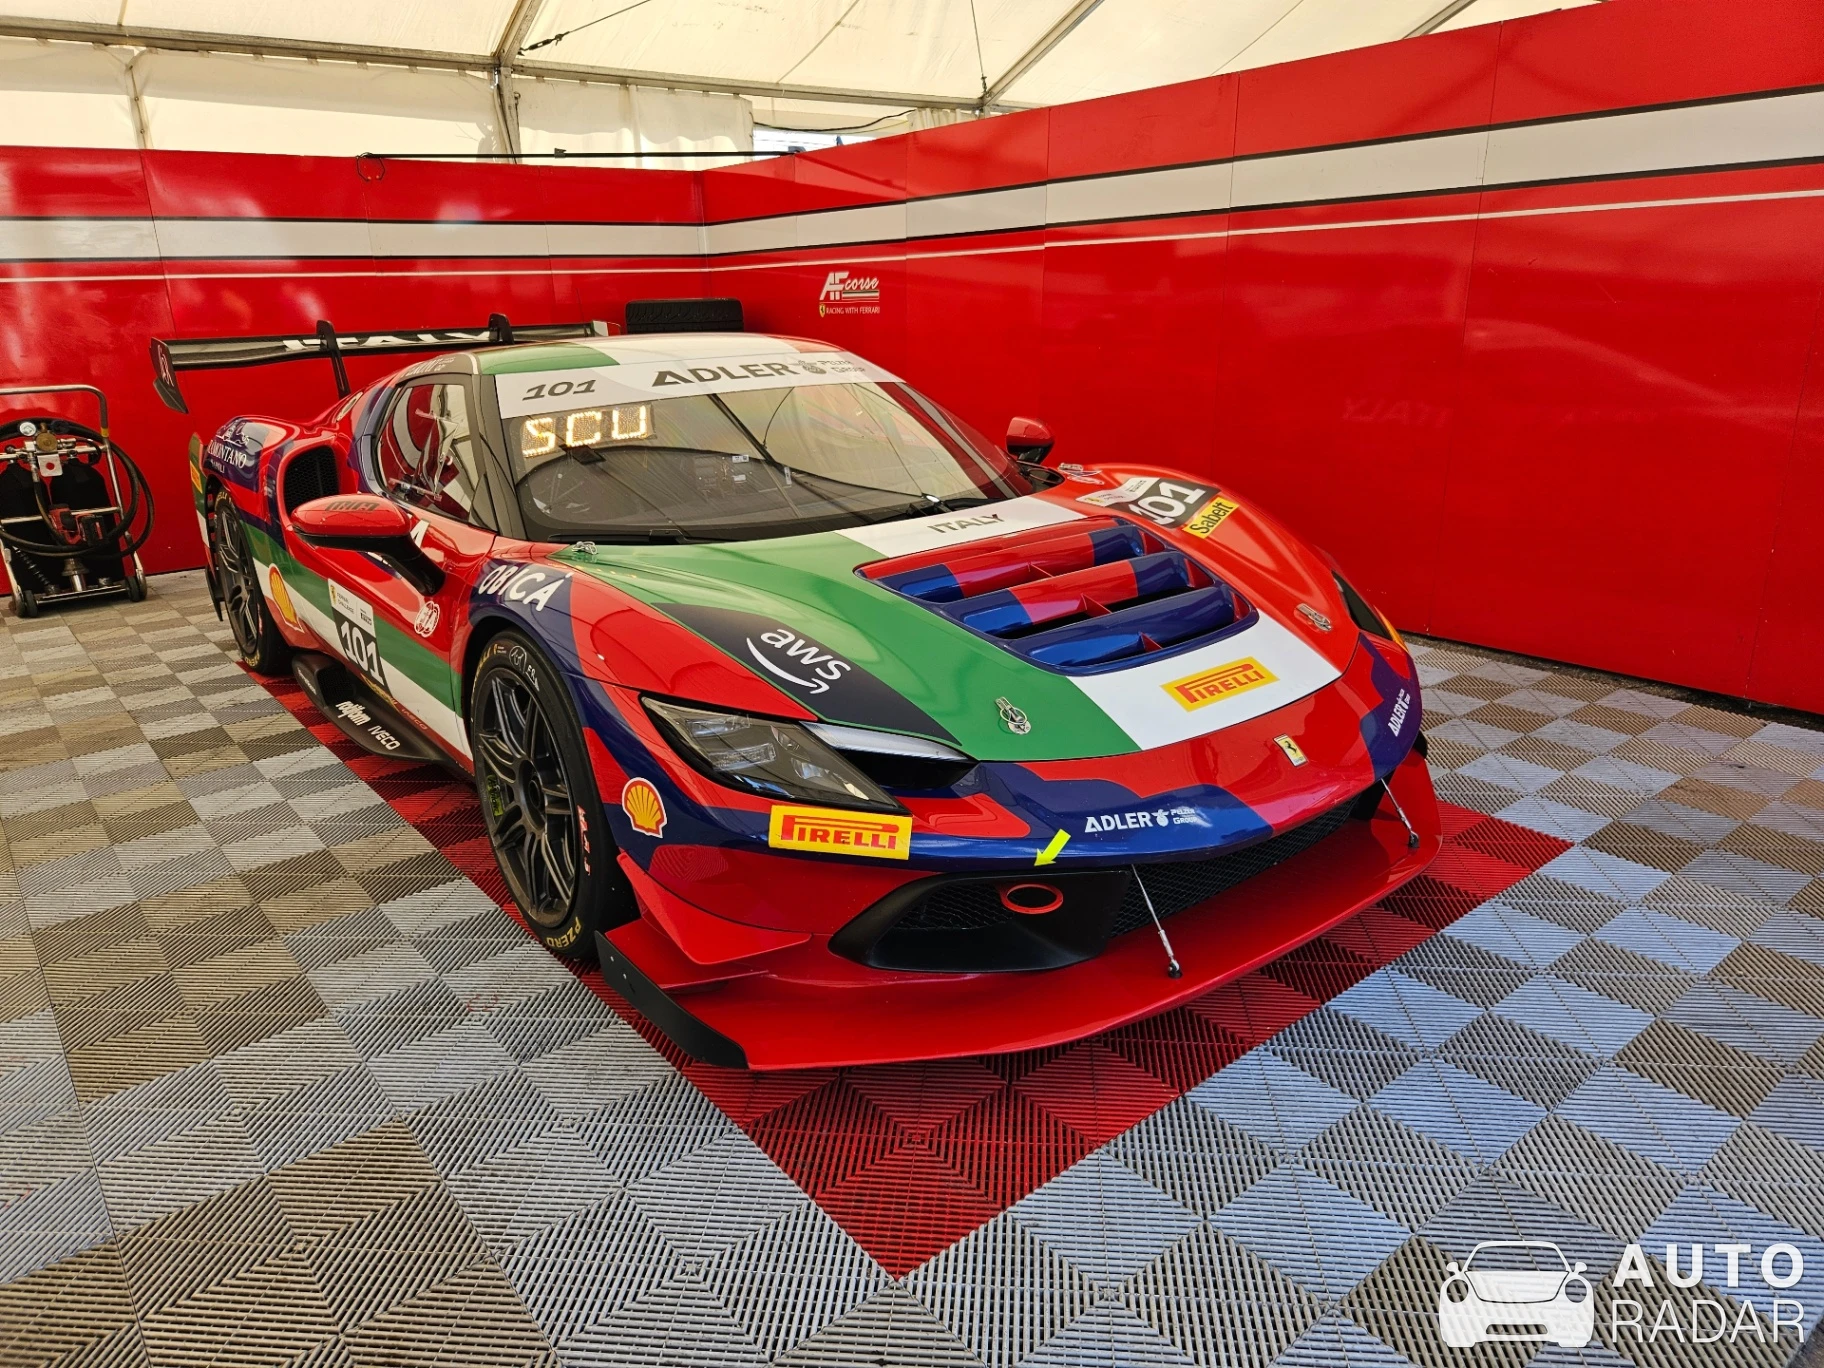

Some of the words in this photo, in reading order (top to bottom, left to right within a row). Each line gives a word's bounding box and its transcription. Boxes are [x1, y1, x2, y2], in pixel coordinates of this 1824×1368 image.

[825, 306, 845, 315] RACING
[845, 306, 859, 315] WITH
[860, 305, 881, 315] FERRARI
[522, 379, 597, 401] 101
[652, 362, 802, 387] ADLER
[1128, 481, 1207, 526] 101
[1189, 501, 1234, 535] Sabelt
[926, 513, 1005, 533] ITALY
[340, 620, 385, 686] 101
[760, 628, 852, 680] aws
[1174, 663, 1266, 704] PIRELLI
[1387, 703, 1407, 737] ADLER
[367, 725, 401, 751] IVECO
[781, 814, 900, 850] PIRELLI
[1084, 811, 1154, 833] ADLER
